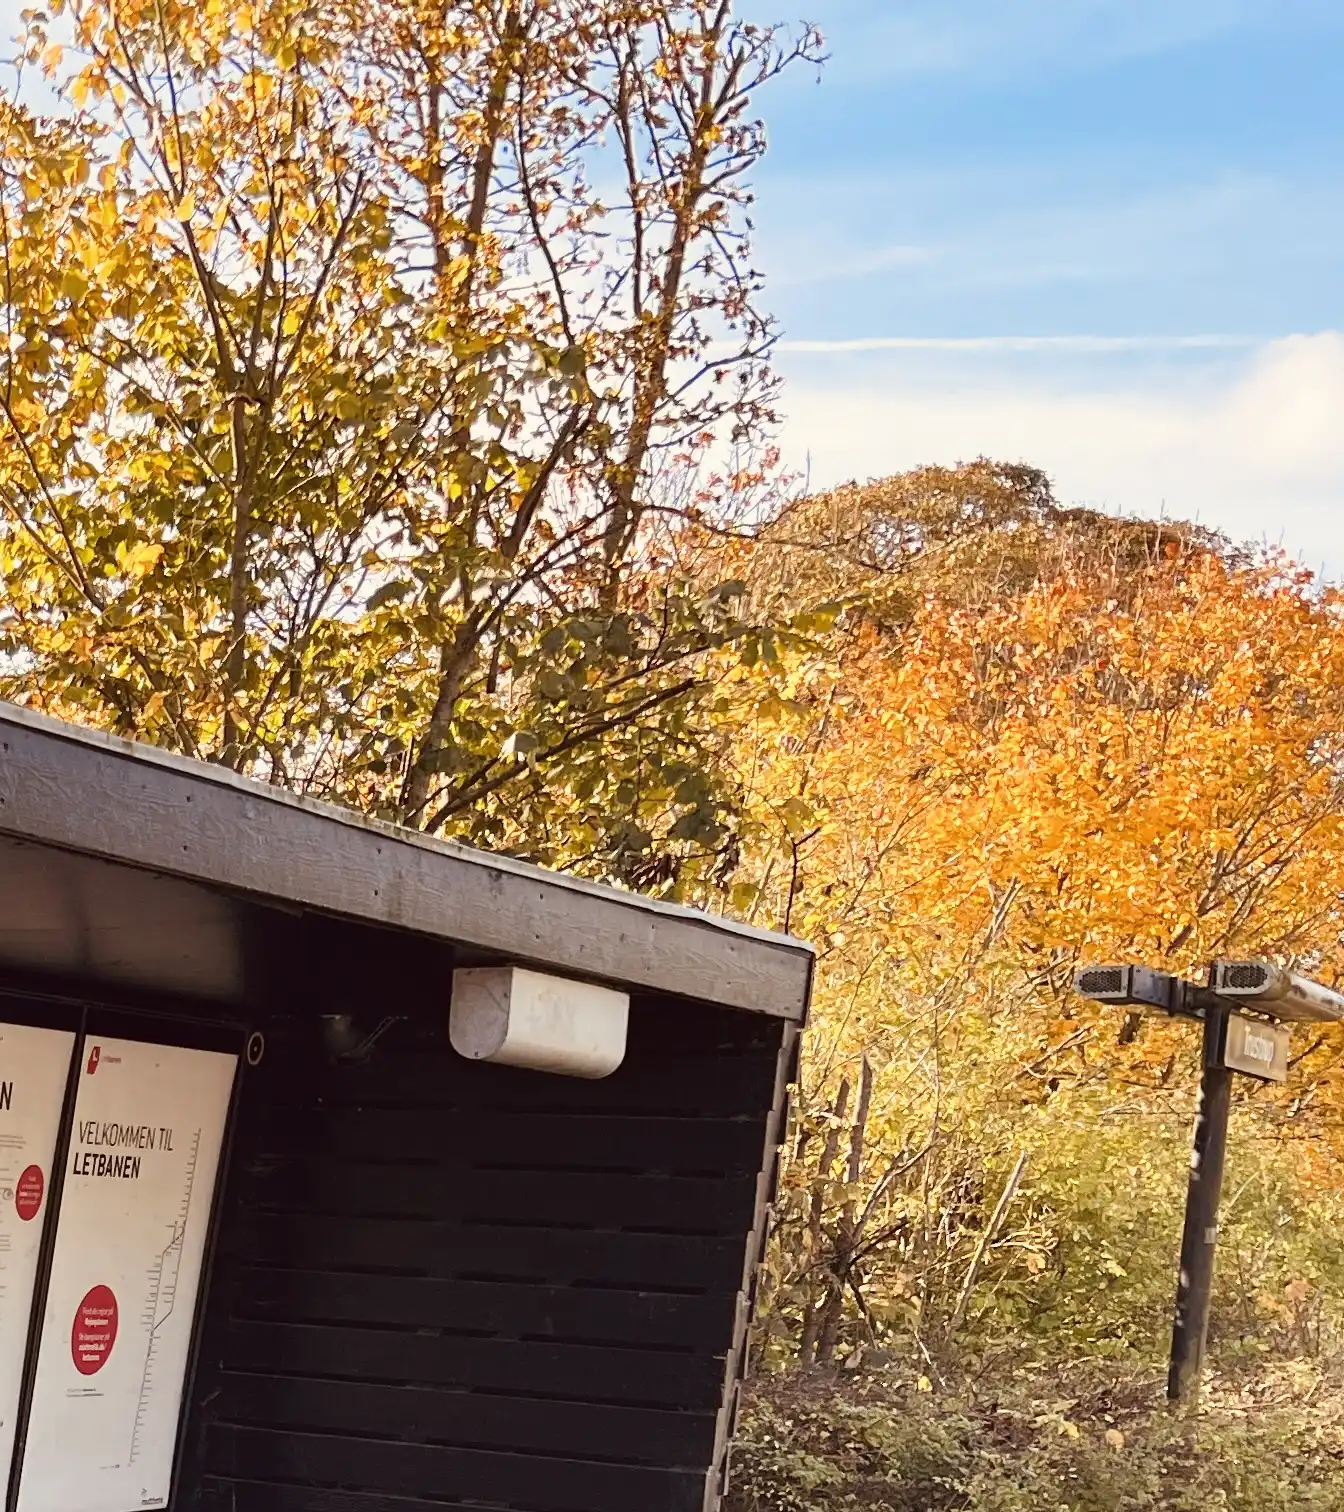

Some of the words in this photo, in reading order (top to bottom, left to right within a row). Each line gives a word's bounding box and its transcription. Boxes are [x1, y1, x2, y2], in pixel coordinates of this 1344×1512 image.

[79, 1120, 156, 1149] VELKOMMEN
[159, 1126, 174, 1151] TIL
[73, 1152, 141, 1180] LETBANEN
